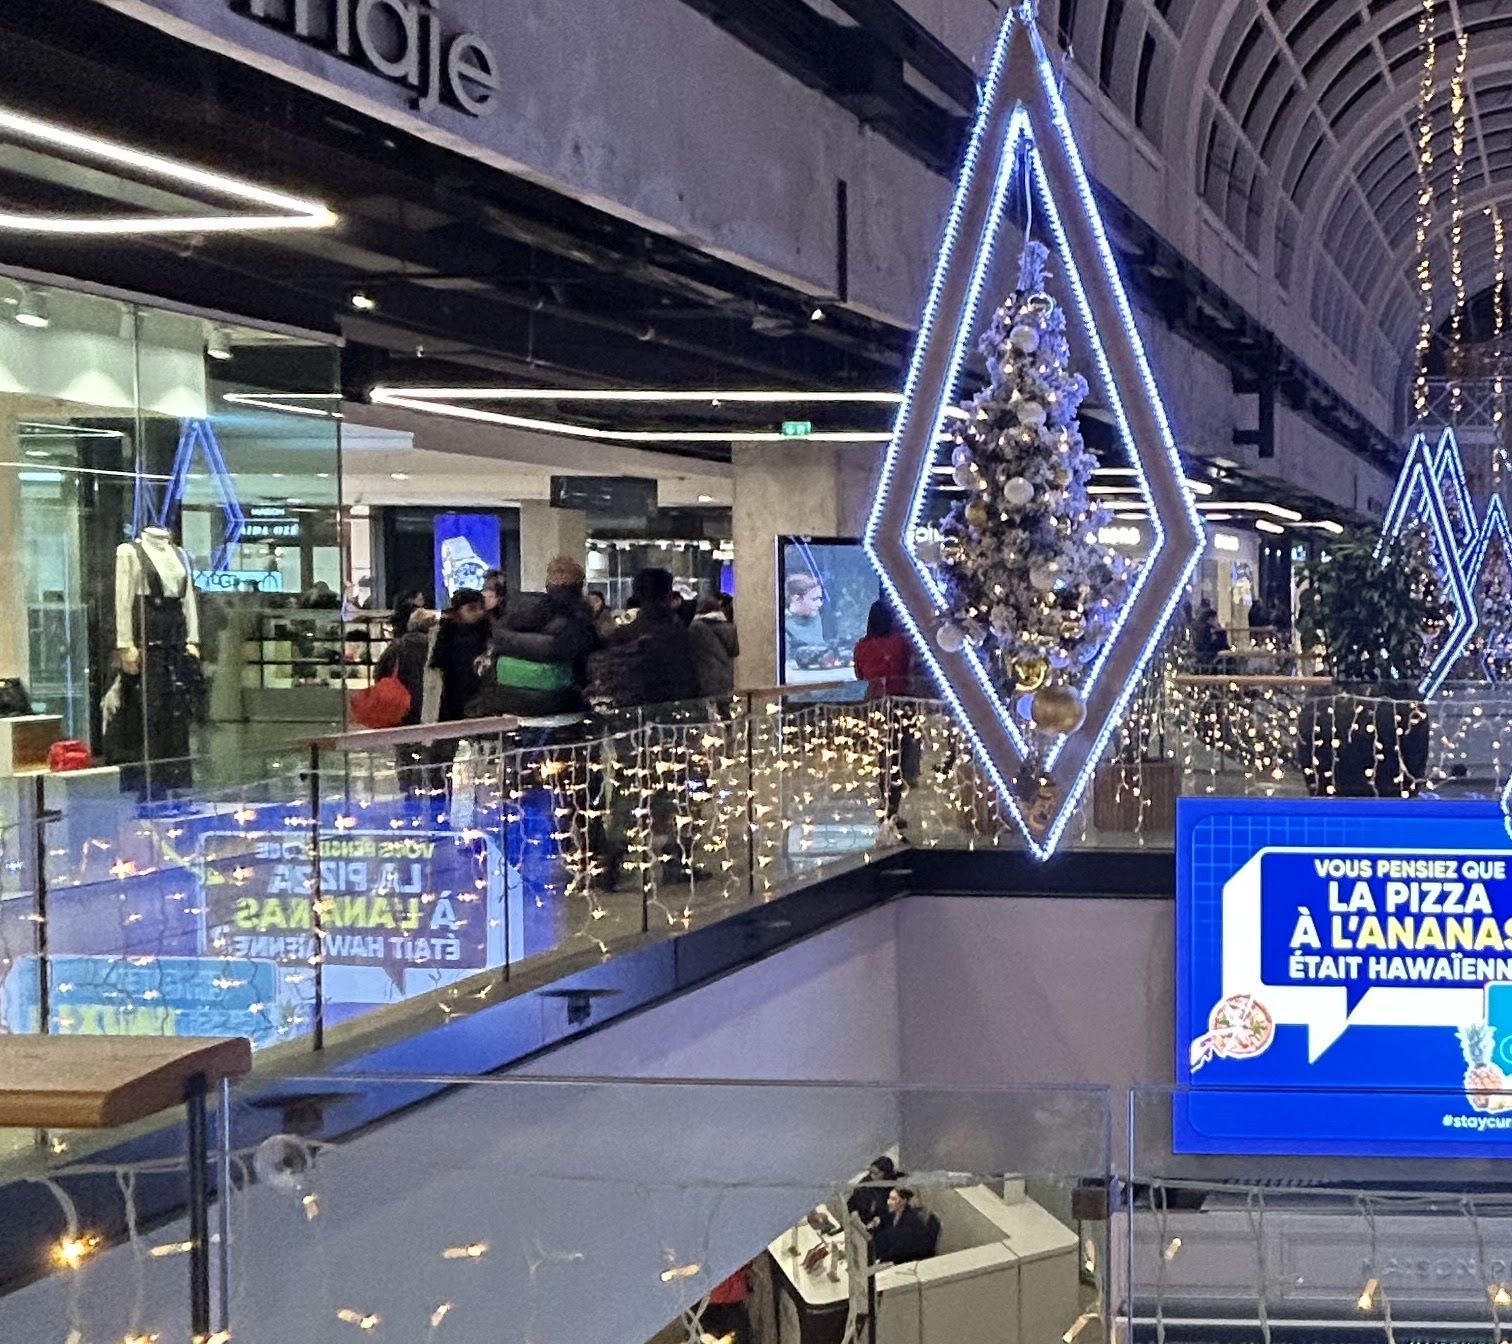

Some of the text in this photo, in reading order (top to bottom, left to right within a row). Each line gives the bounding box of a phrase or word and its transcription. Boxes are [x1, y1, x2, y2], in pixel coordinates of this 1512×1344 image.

[1314, 859, 1507, 880] VOUS PENSIEZ QUE
[1329, 881, 1493, 914] LA PIZZA
[1289, 906, 1322, 949] À
[1289, 950, 1363, 979] ÉTAIT
